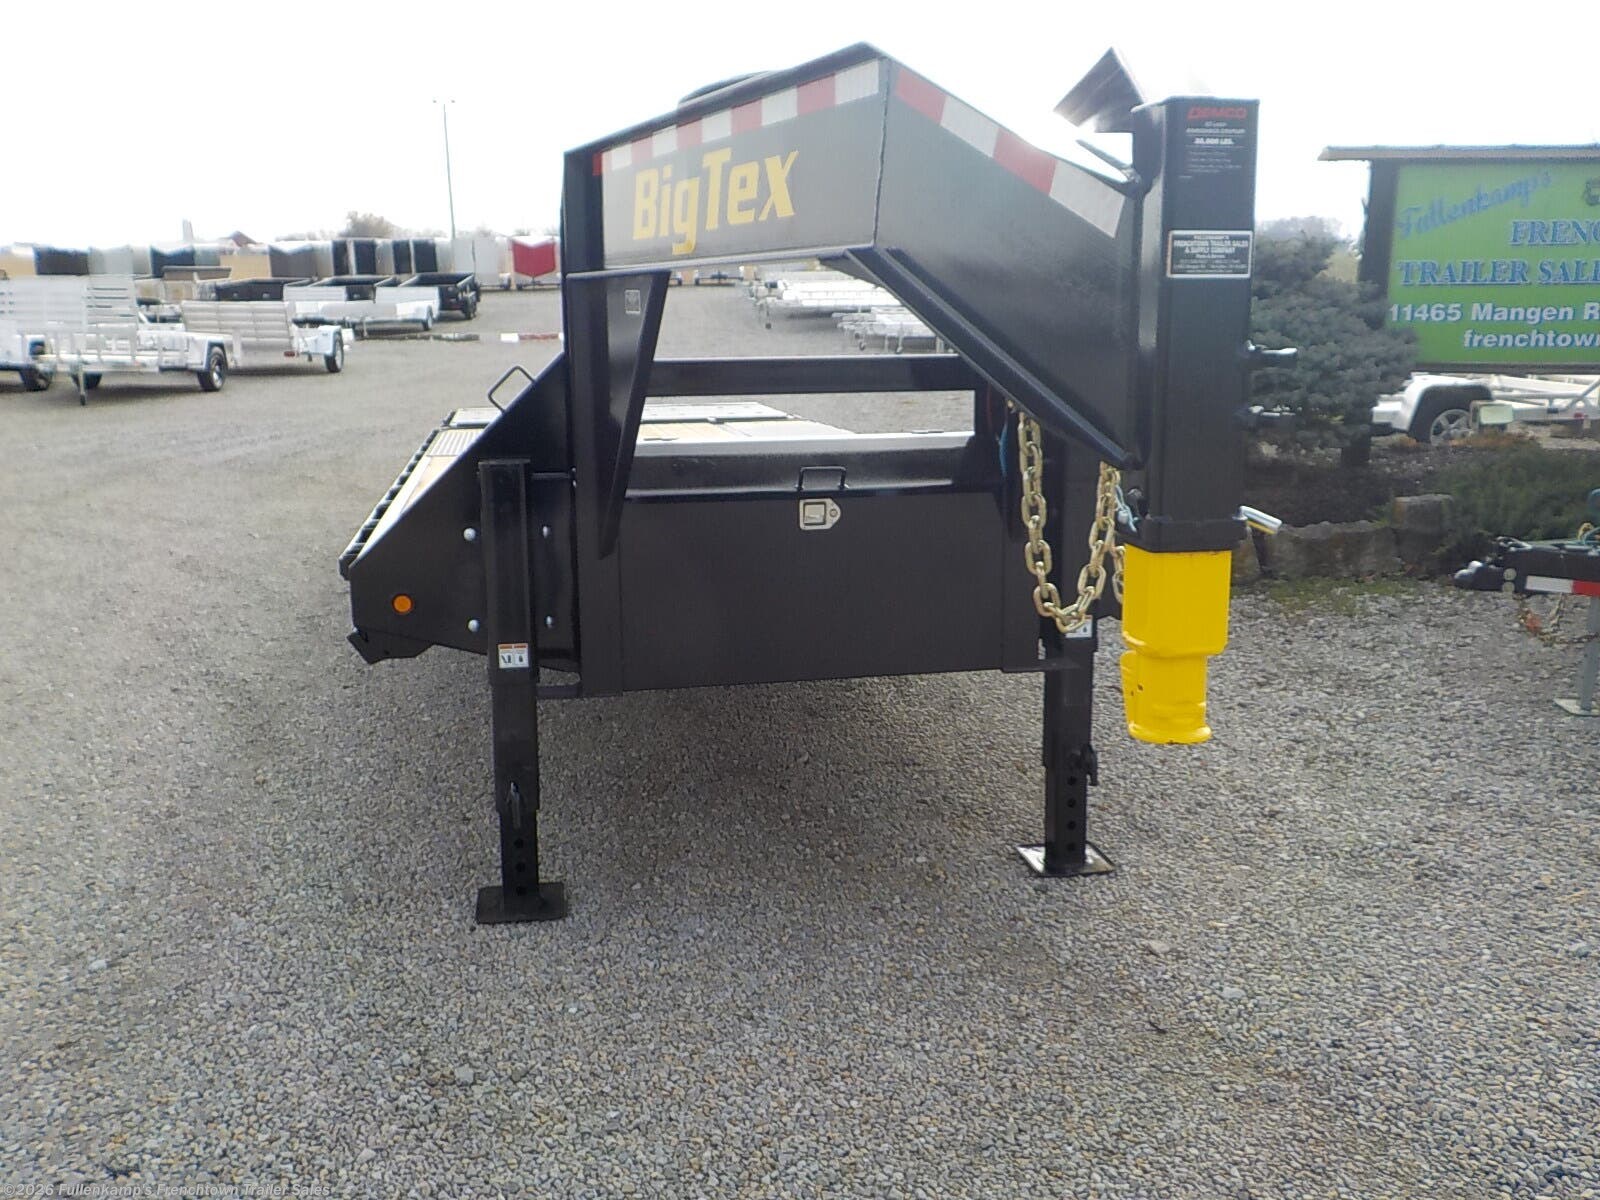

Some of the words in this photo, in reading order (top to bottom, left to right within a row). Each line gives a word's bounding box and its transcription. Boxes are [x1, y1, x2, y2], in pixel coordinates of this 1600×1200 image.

[1399, 260, 1530, 285] TRAILER
[1390, 303, 1462, 321] 11465
[1471, 302, 1574, 323] Mangen
